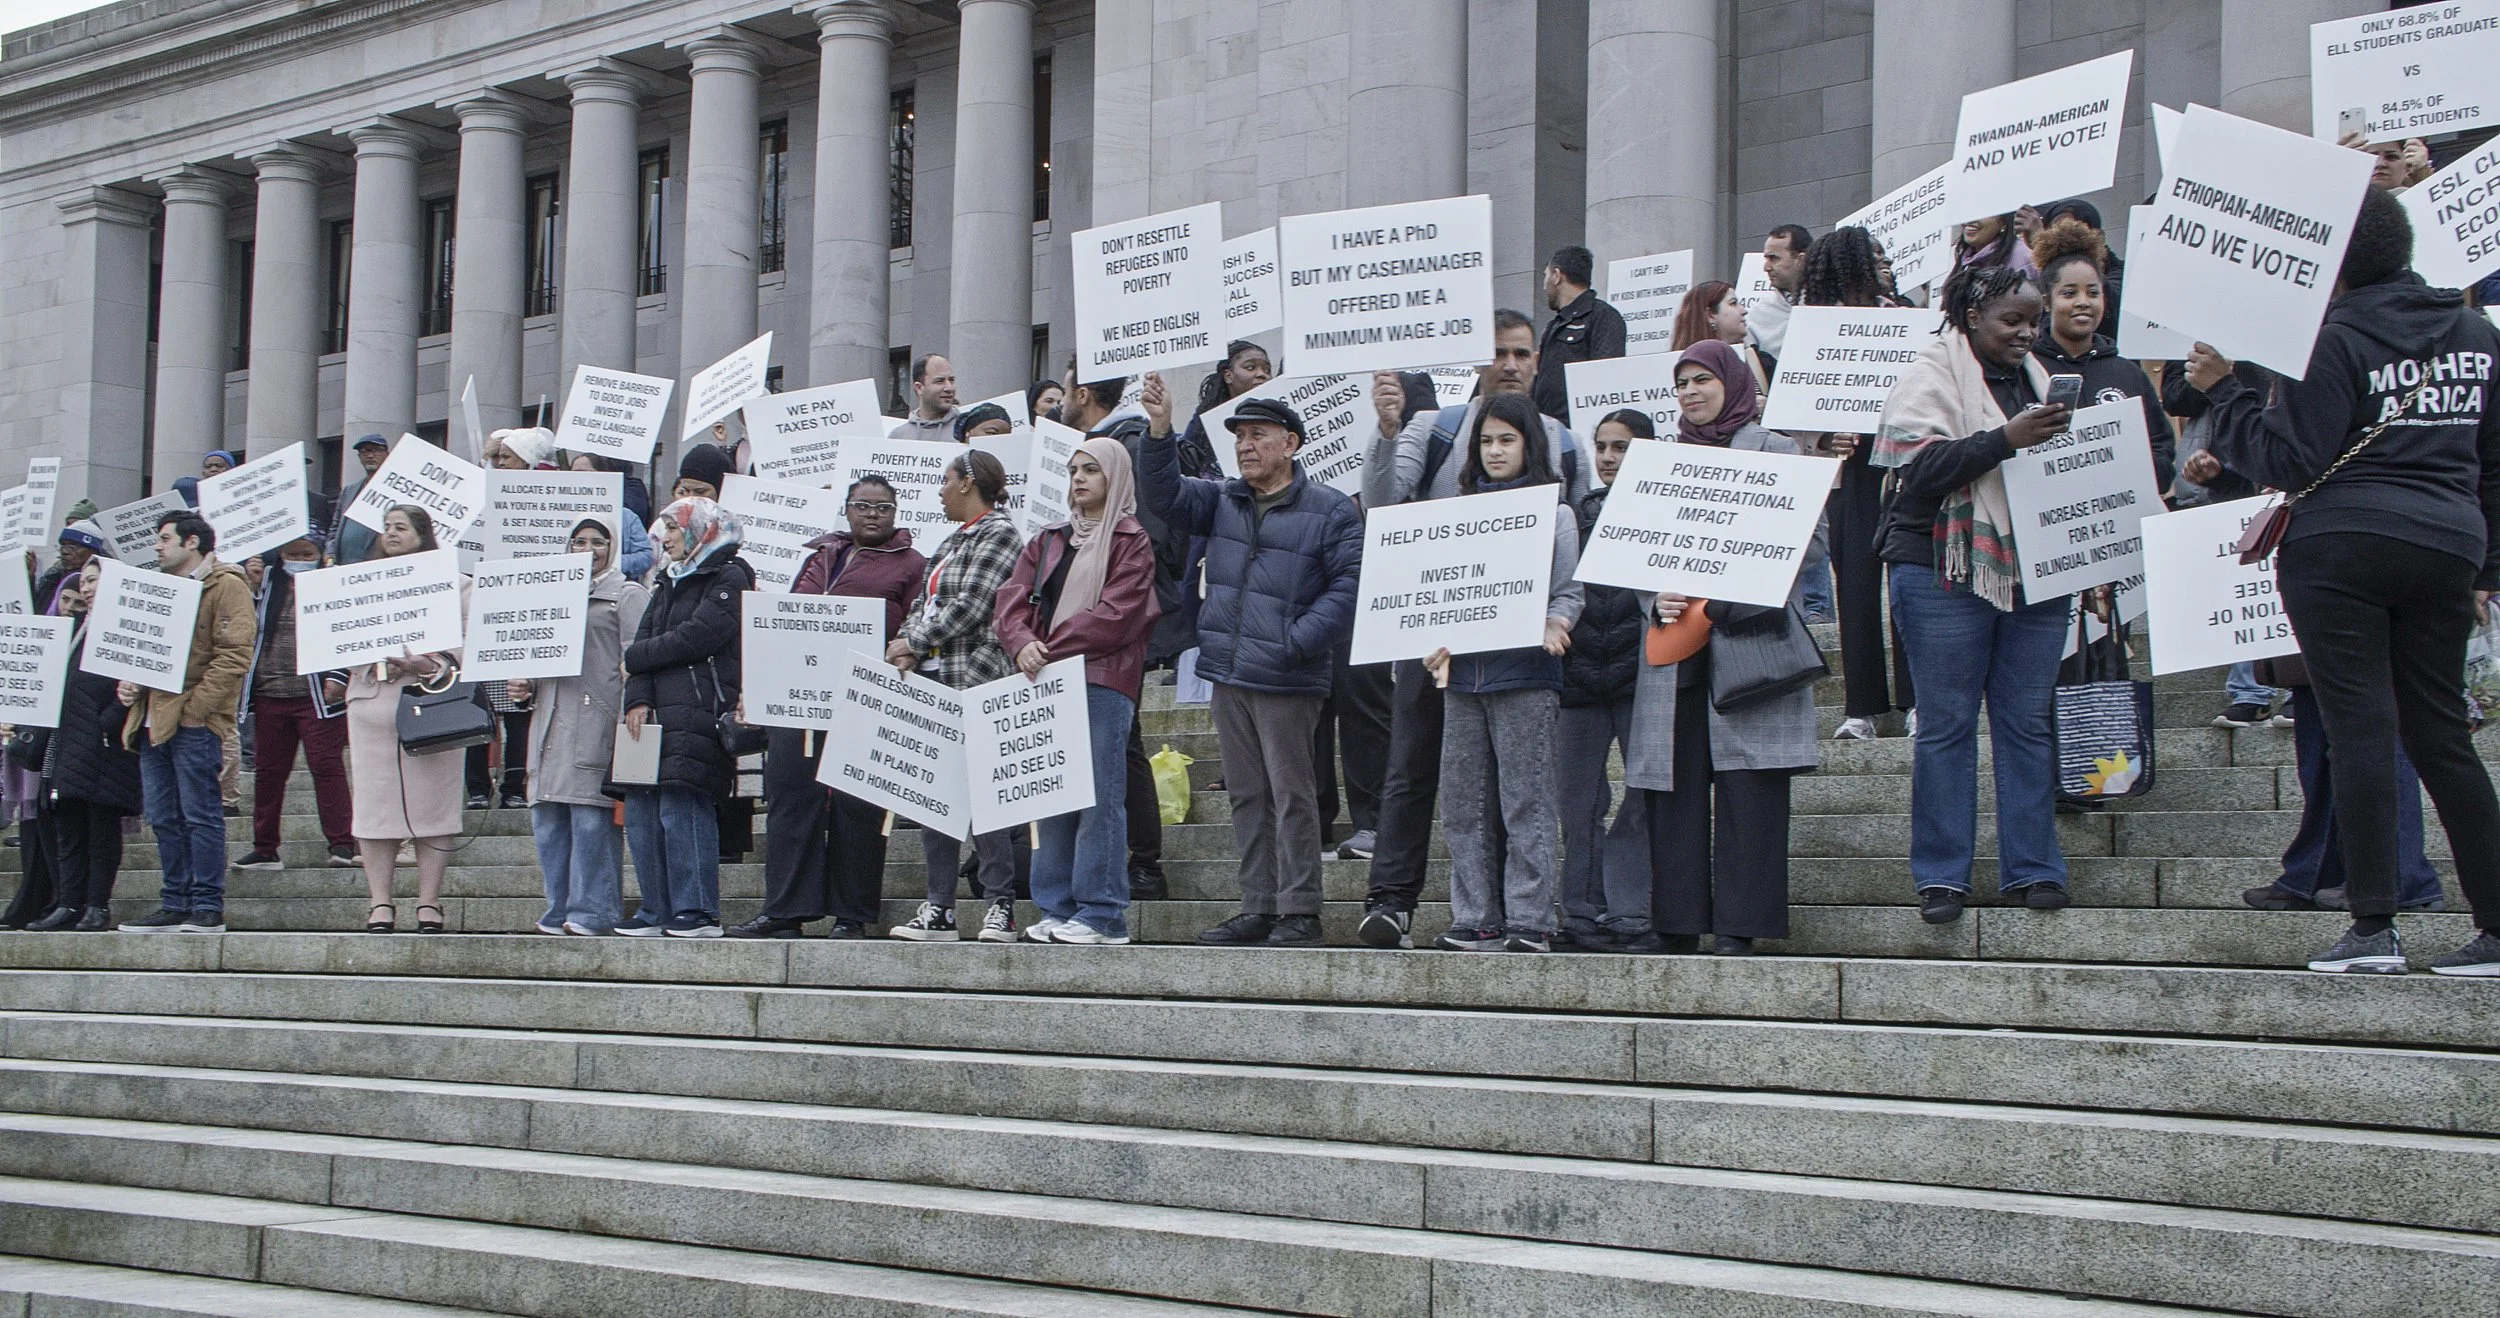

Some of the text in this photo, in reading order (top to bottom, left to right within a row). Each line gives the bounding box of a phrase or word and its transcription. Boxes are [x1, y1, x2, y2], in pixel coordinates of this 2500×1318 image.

[2327, 16, 2498, 56] ELL STUDENTS GRADUATE
[1968, 98, 2109, 147] RWANDAN-AMERICAN
[1962, 121, 2107, 173] AND WE VOTE!
[2172, 177, 2332, 246] ETHIOPIAN-AMERICAN
[1102, 222, 1190, 255] DON'T RESETTLE
[1341, 228, 1385, 249] HAVE
[1388, 227, 1401, 244] A
[1404, 223, 1438, 242] PhD
[1105, 246, 1188, 276] REFUGEES INTO
[2157, 214, 2320, 289] AND WE VOTE!
[1290, 251, 1483, 287] BUT MY CASEMANAGER
[1633, 266, 1652, 278] CAN'T
[1652, 264, 1669, 275] HELP
[1123, 271, 1172, 295] POVERTY
[1328, 288, 1447, 315] OFFERED ME A
[1102, 311, 1200, 342] WE NEED ENGLISH
[1305, 318, 1472, 350] MINIMUM WAGE JOB
[1838, 323, 1909, 338] EVALUATE
[1094, 331, 1209, 366] LANGUAGE TO THRIVE
[1815, 347, 1859, 361] STATE
[583, 374, 661, 396] REMOVE BARRIERS
[589, 389, 648, 408] TO GOOD JOBS
[786, 399, 836, 416] WE PAY
[2377, 385, 2481, 423] ARICA
[571, 415, 647, 437] ENLIGH LANGUAGE
[775, 412, 854, 434] TAXES TOO!
[2075, 419, 2121, 444] INEQUITY
[586, 432, 624, 448] CLASSES
[1670, 462, 1778, 486] POVERTY HAS
[2043, 446, 2114, 476] IN EDUCATION
[500, 484, 607, 496] ALLOCATE $7 MILLION TO
[1635, 480, 1795, 511] INTERGENERATIONAL
[1676, 506, 1739, 526] IMPACT
[2038, 489, 2136, 527] INCREASE FUNDING
[1380, 514, 1537, 547] HELP US SUCCEED
[1599, 524, 1797, 560] SUPPORT US TO SUPPORT
[2068, 519, 2116, 544] FOR K-12
[348, 570, 383, 585] CAN'T
[385, 565, 414, 579] HELP
[1420, 562, 1486, 584] INVEST IN
[1647, 552, 1727, 575] OUR KIDS!
[120, 578, 178, 600] PUT YOURSELF
[478, 567, 584, 589] DON'T FORGET US
[118, 595, 172, 617] IN OUR SHOES
[303, 581, 454, 614] MY KIDS WITH HOMEWORK
[777, 600, 848, 616] ONLY 68.8% OF
[1369, 579, 1533, 611] ADULT ESL INSTRUCTION
[118, 617, 165, 638] WOULD YOU
[330, 615, 384, 633] BECAUSE
[393, 607, 428, 622] DON'T
[483, 607, 571, 625] WHERE IS THE BILL
[753, 616, 873, 635] ELL STUDENTS GRADUATE
[1399, 604, 1498, 629] FOR REFUGEES
[102, 631, 173, 656] SURVIVE WITHOUT
[335, 630, 425, 654] SPEAK ENGLISH
[495, 626, 554, 642] TO ADDRESS
[94, 646, 173, 673] SPEAKING ENGLISH?
[477, 644, 568, 662] REFUGEES' NEEDS?
[804, 654, 818, 667] VS
[788, 688, 833, 702] 84.5% OF
[852, 664, 936, 707] HOMELESSNESS
[982, 678, 1064, 715] GIVE US TIME
[846, 688, 959, 742] IN OUR COMMUNITIES
[993, 704, 1055, 734] TO LEARN
[876, 725, 939, 760] INCLUDE US
[999, 728, 1053, 757] ENGLISH
[869, 748, 934, 784] IN PLANS TO
[992, 749, 1066, 783] AND SEE US
[842, 763, 950, 816] END HOMELESSNESS
[997, 774, 1063, 805] FLOURISH!
